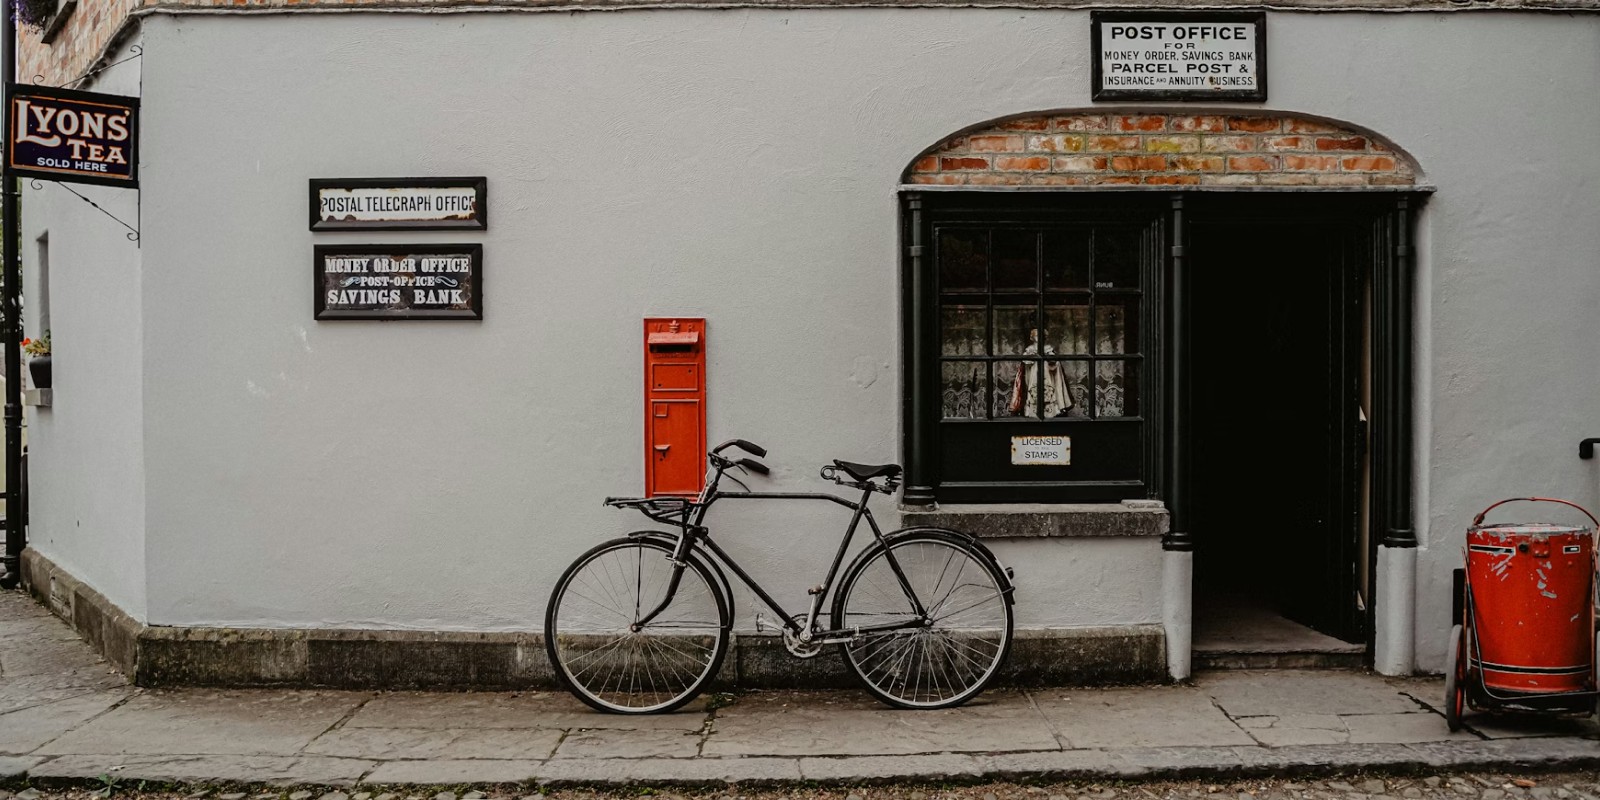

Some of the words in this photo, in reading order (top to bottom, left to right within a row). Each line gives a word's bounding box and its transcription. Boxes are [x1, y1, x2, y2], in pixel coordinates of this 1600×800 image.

[1111, 26, 1167, 40] POST
[1173, 26, 1247, 40] OFFICE
[1104, 51, 1139, 60] MONEY
[1182, 51, 1224, 61] SAVINGS
[1111, 63, 1178, 73] PARCEL
[1186, 63, 1232, 73] POST
[1239, 63, 1249, 73] &
[1104, 76, 1154, 85] INSURANCE
[1168, 76, 1205, 86] ANNUITY
[66, 138, 127, 164] TEA
[37, 157, 70, 168] SOLD
[74, 161, 108, 172] HERE
[321, 196, 363, 212] POSTAL
[325, 258, 370, 273] MONEY
[373, 258, 417, 273] ORDER
[421, 258, 469, 273] OFFICE
[360, 276, 435, 287] POST-OFFICE
[327, 289, 400, 304] SAVINGS
[1024, 451, 1058, 459] STAMPS
